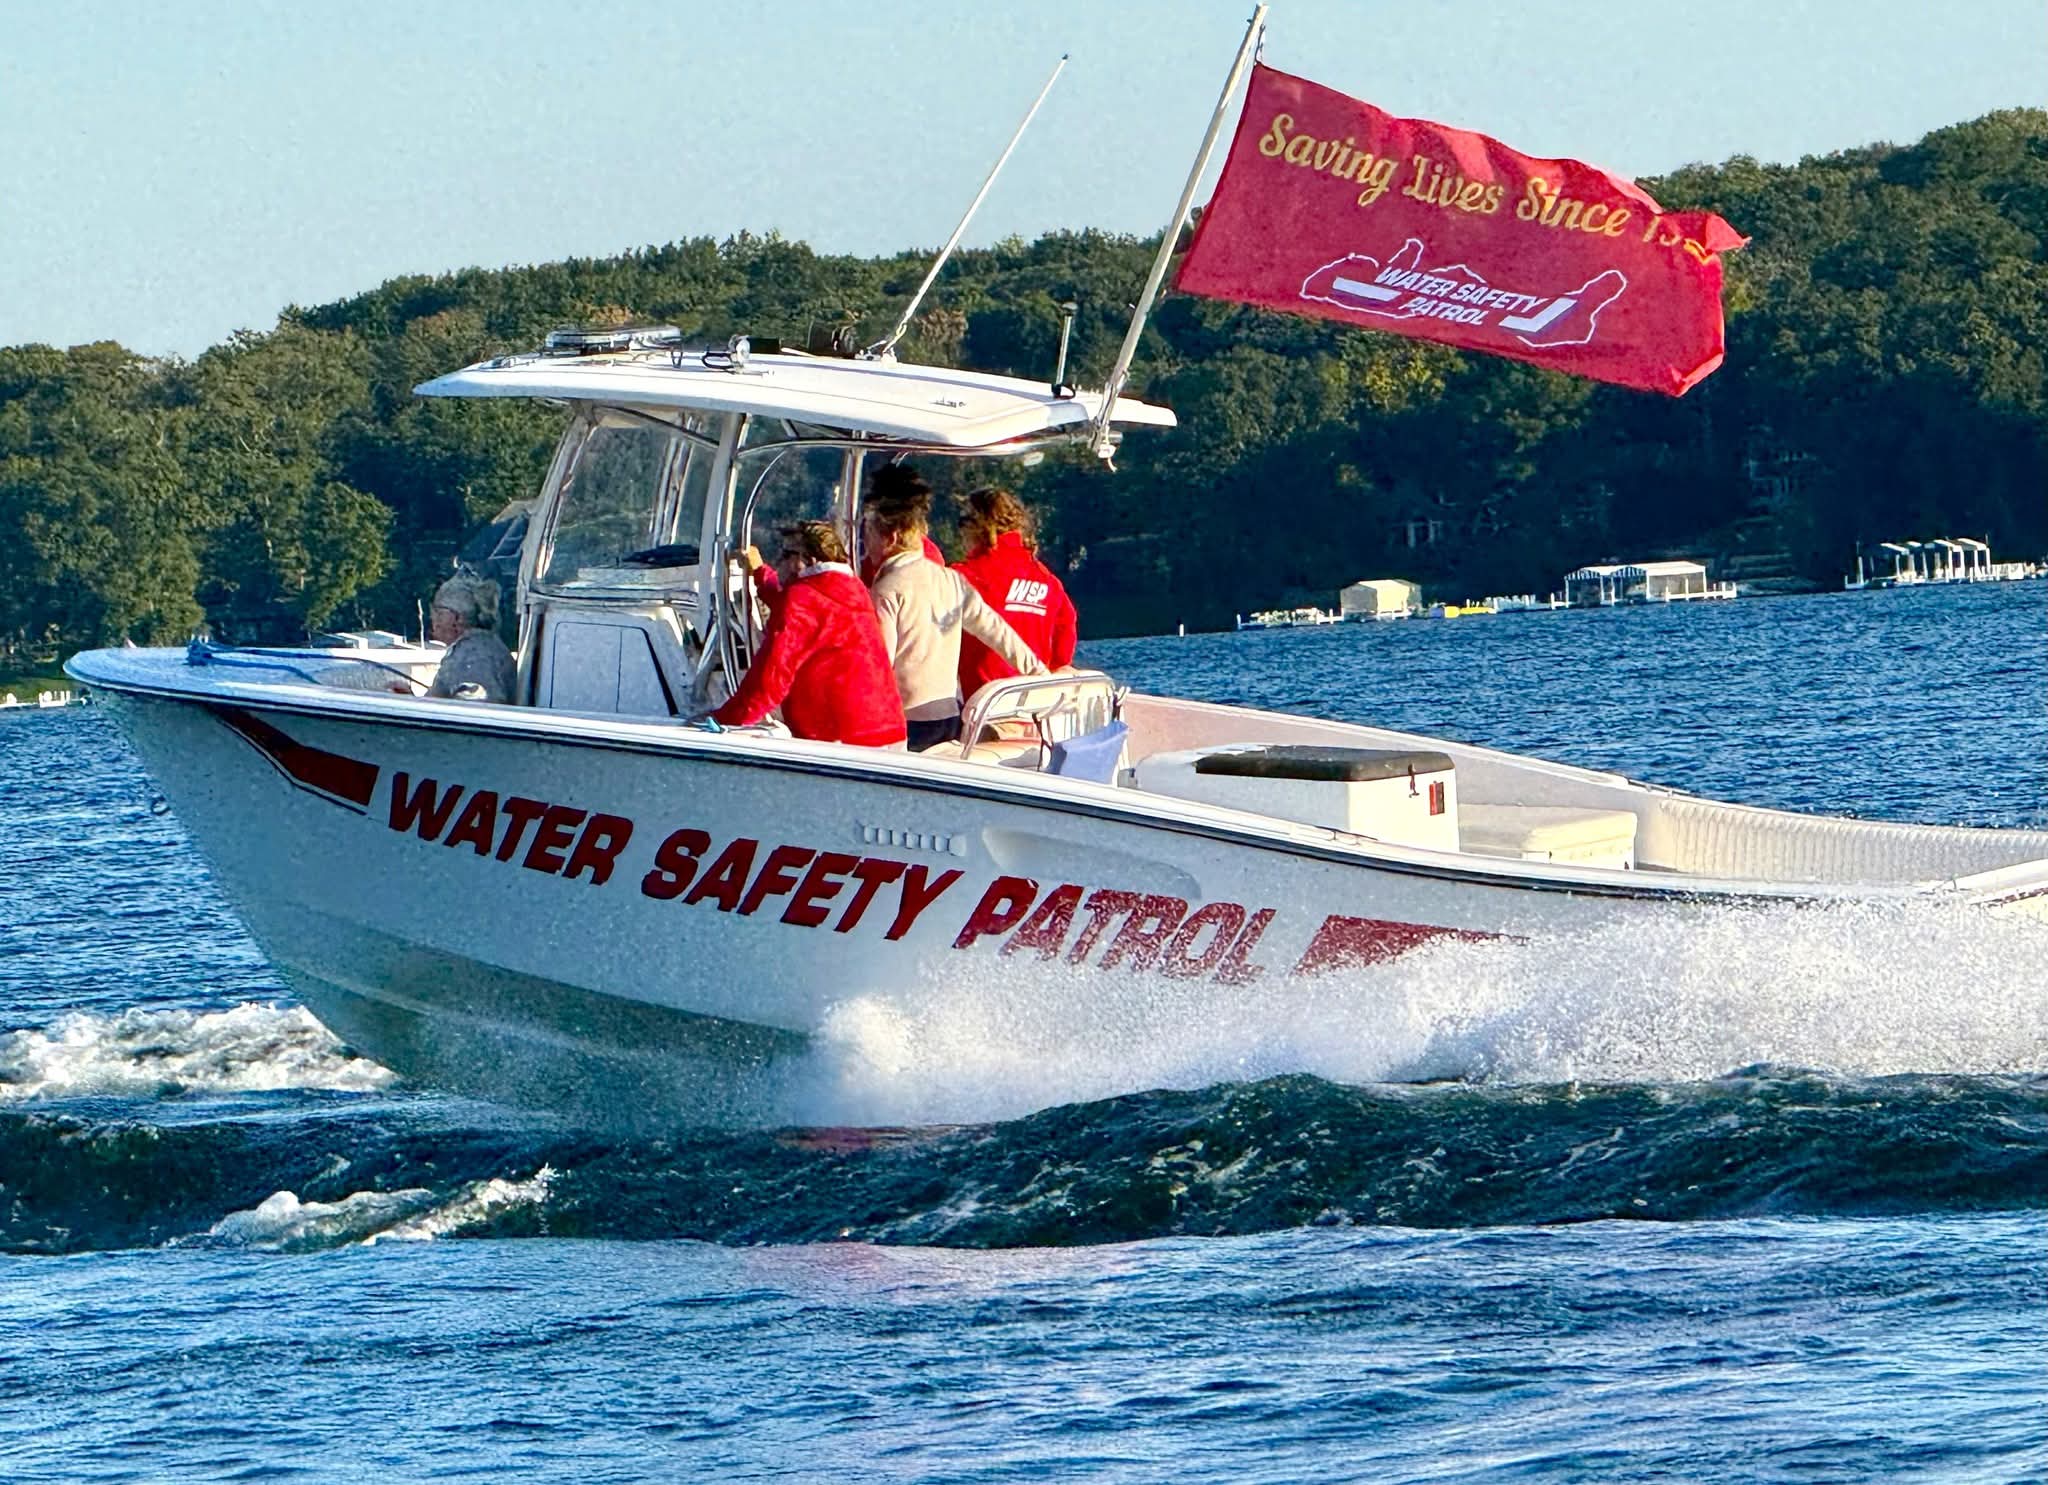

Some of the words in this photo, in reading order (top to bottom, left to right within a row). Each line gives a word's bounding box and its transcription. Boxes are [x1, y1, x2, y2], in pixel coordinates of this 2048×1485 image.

[1259, 114, 1397, 206] Saving
[1403, 154, 1503, 213] Lives
[1517, 177, 1631, 235] Since
[1375, 267, 1459, 297] WATER
[1452, 282, 1549, 313] SAFETY
[1399, 296, 1488, 326] PATROL
[1005, 578, 1048, 603] WSP
[388, 771, 633, 885] WATER
[641, 828, 964, 941] SAFETY
[952, 875, 1276, 985] PATROL
